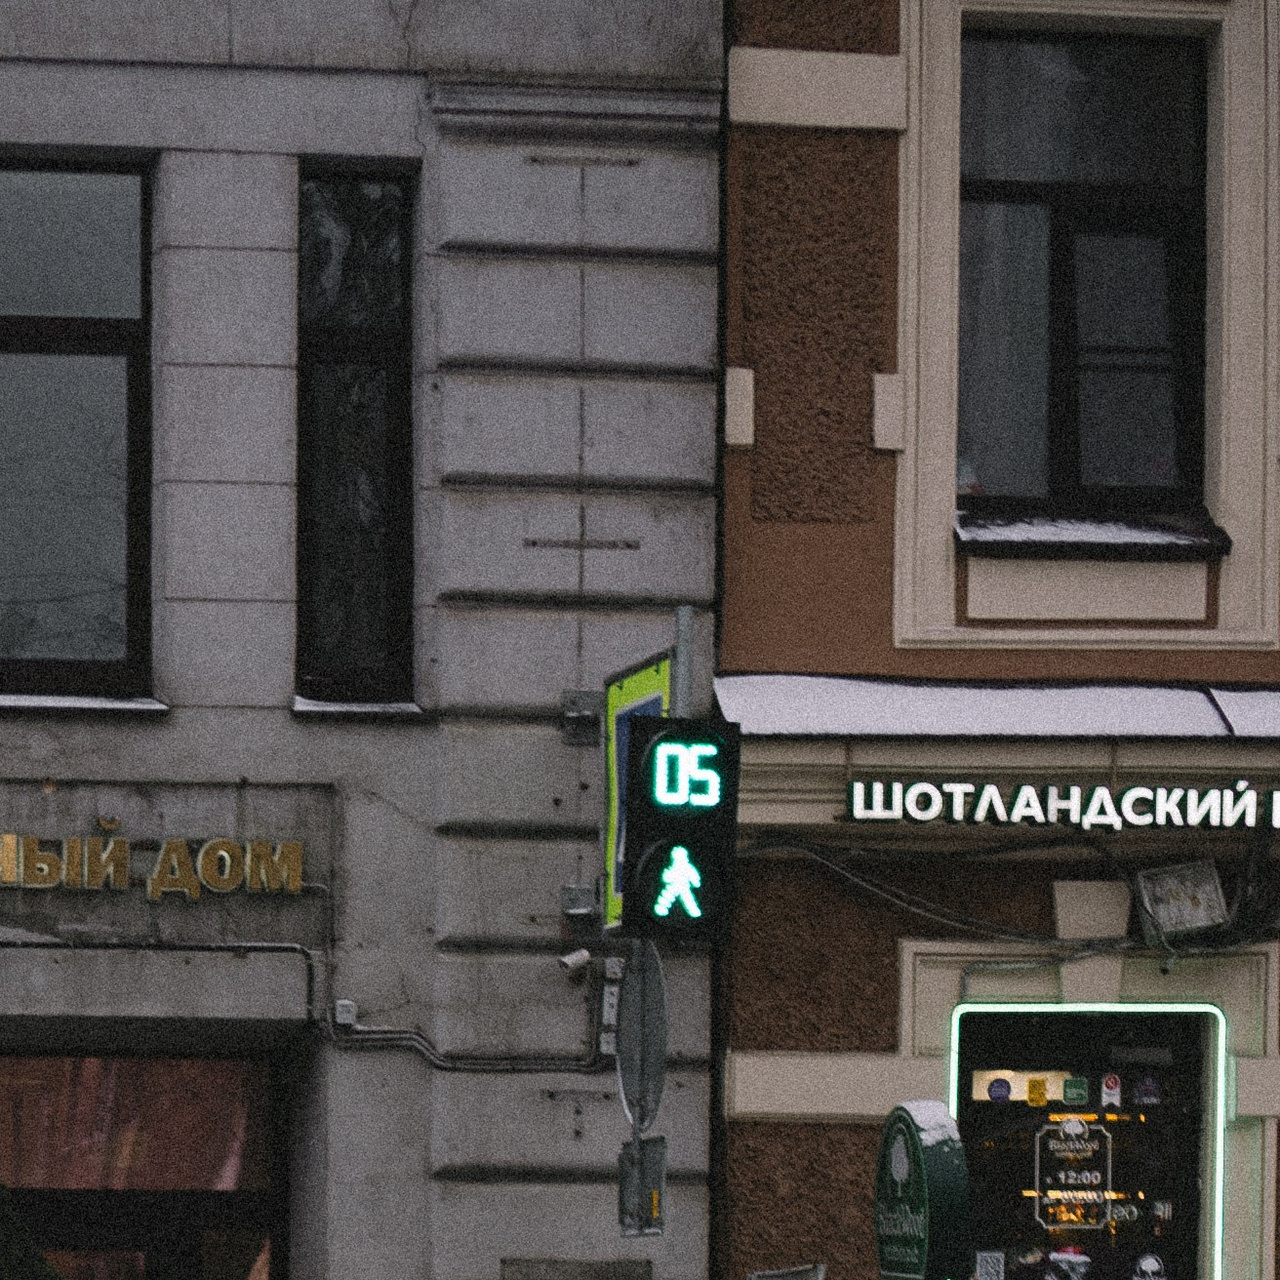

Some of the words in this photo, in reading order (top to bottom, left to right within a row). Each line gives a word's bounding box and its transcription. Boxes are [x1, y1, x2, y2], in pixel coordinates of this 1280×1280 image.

[655, 742, 720, 806] 05
[852, 780, 1257, 831] ШОТЛАНДСКИЙ
[147, 837, 303, 900] ДОМ
[1057, 1170, 1102, 1184] 12:00
